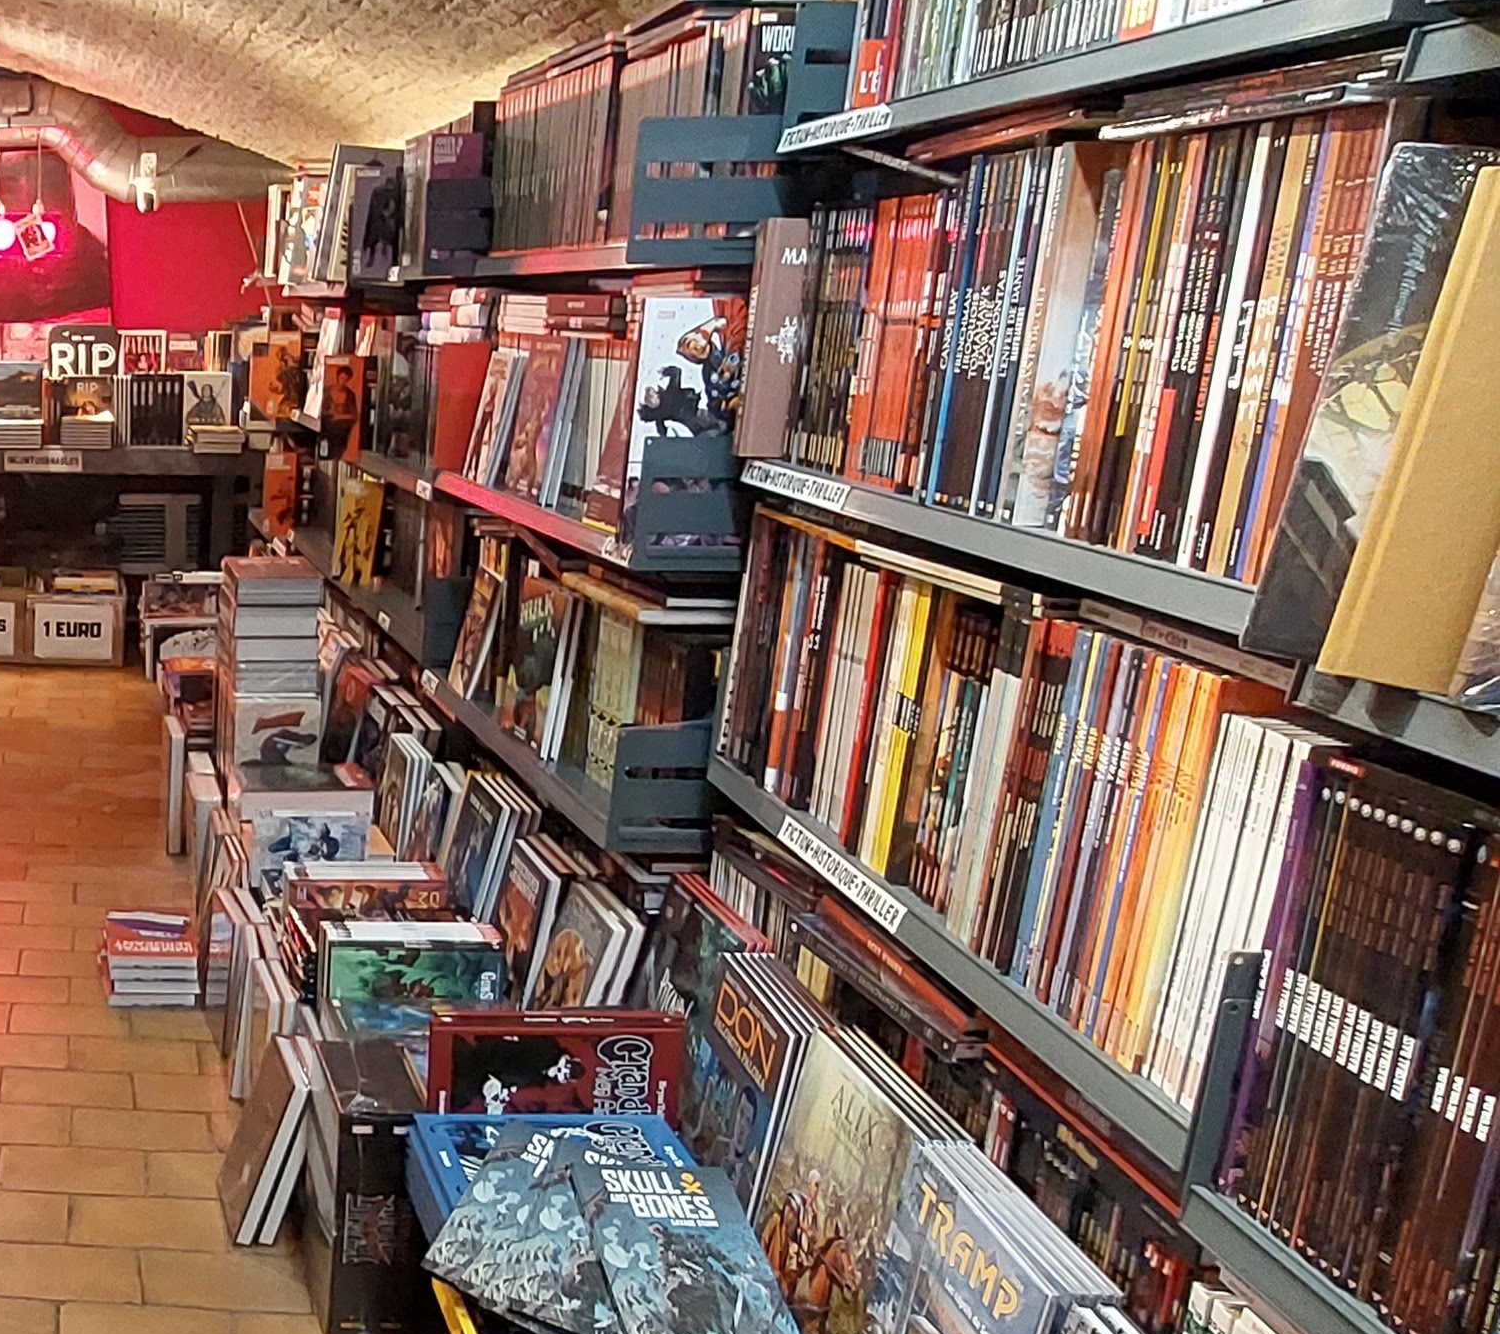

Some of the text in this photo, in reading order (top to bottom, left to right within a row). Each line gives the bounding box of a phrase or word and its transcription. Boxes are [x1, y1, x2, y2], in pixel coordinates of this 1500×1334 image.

[982, 269, 1008, 381] POCAHONTAS
[51, 342, 116, 377] RIP
[76, 382, 99, 394] RIP
[43, 621, 102, 638] 1 EURO
[715, 980, 777, 1080] DON
[830, 1084, 878, 1145] ALIX
[601, 1168, 681, 1196] SKULL
[610, 1193, 718, 1220] AND BONES
[915, 1181, 1019, 1321] TRAMP
